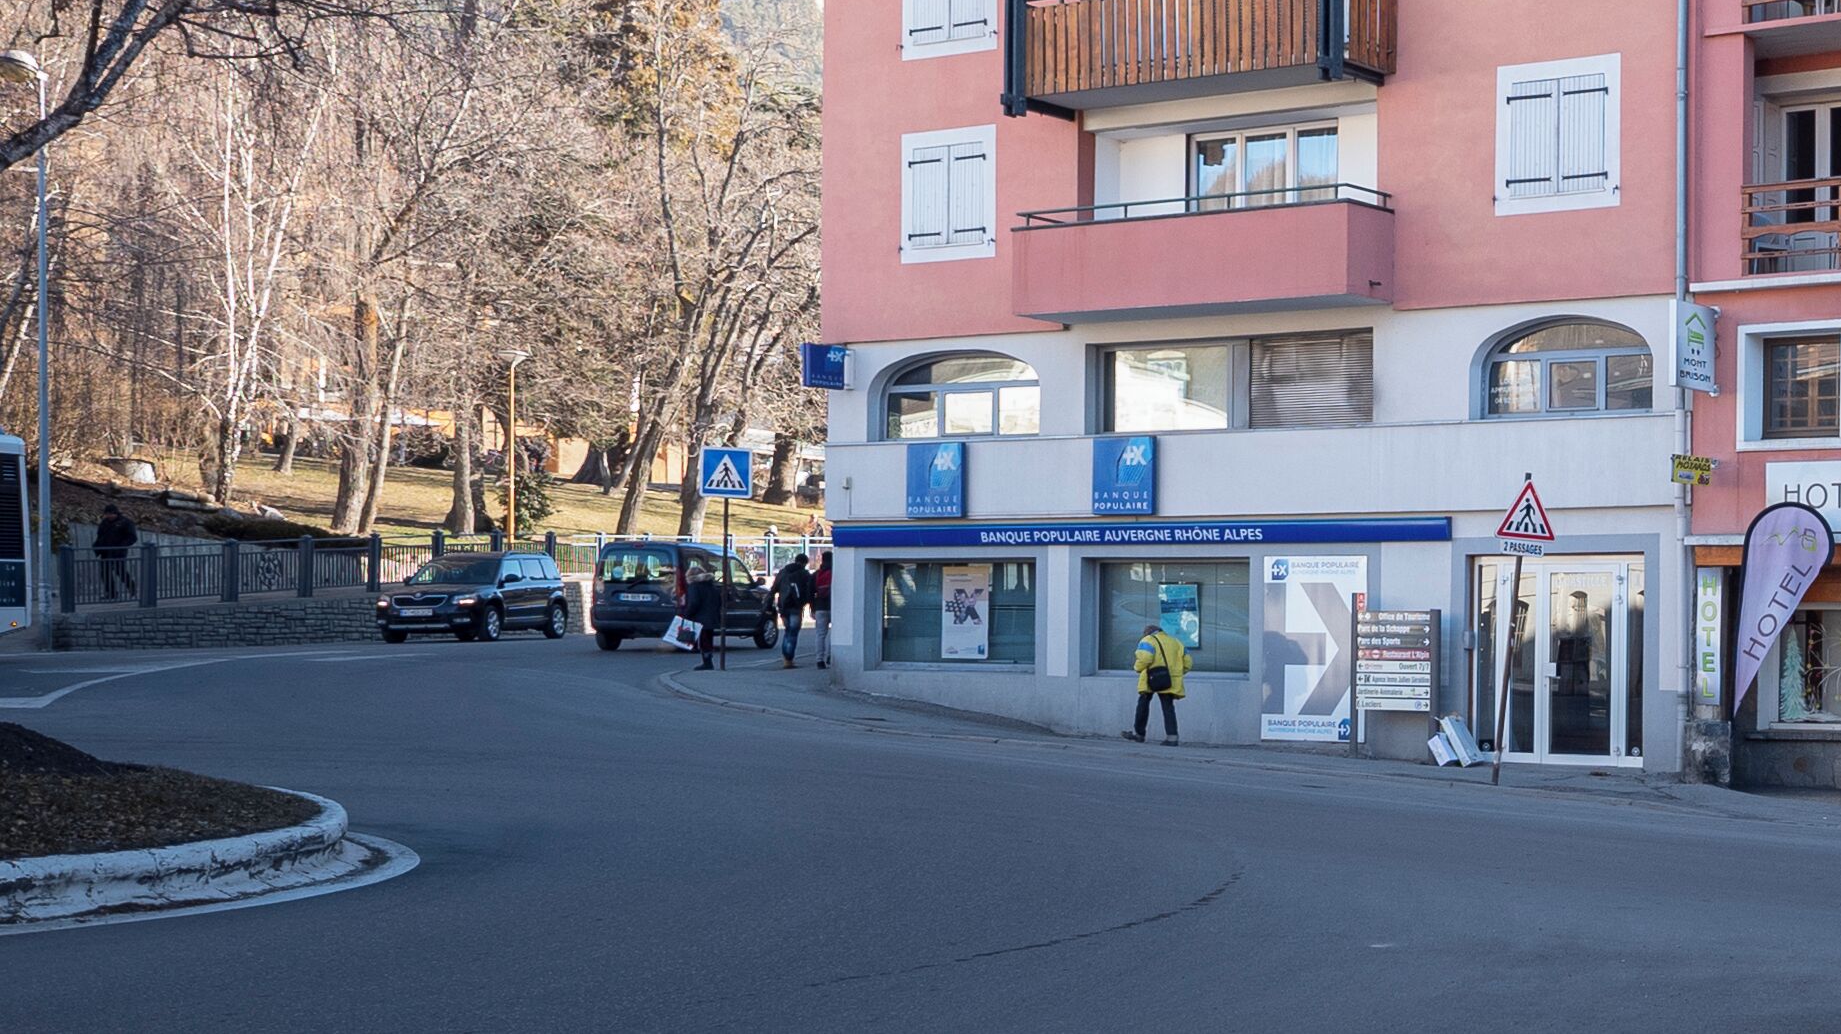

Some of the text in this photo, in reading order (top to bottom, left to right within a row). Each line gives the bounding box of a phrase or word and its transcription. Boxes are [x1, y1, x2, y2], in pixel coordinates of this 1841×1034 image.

[1683, 357, 1707, 368] MONT
[1680, 369, 1711, 383] BRISON
[908, 495, 958, 504] BANQUE
[1094, 490, 1148, 499] BANQUE
[907, 505, 958, 514] POPULAIRE
[1094, 501, 1148, 510] POPULAIRE
[980, 526, 1263, 544] BANQUE POPULAIRE AUVERGNE RHÔNE ALPES
[1509, 542, 1543, 556] PASSAGES
[1742, 564, 1813, 662] HOTEL
[1357, 637, 1400, 646] Parc des Sports
[1702, 576, 1718, 698] HOTEL
[1268, 719, 1336, 728] BANQUE POPULAIRE
